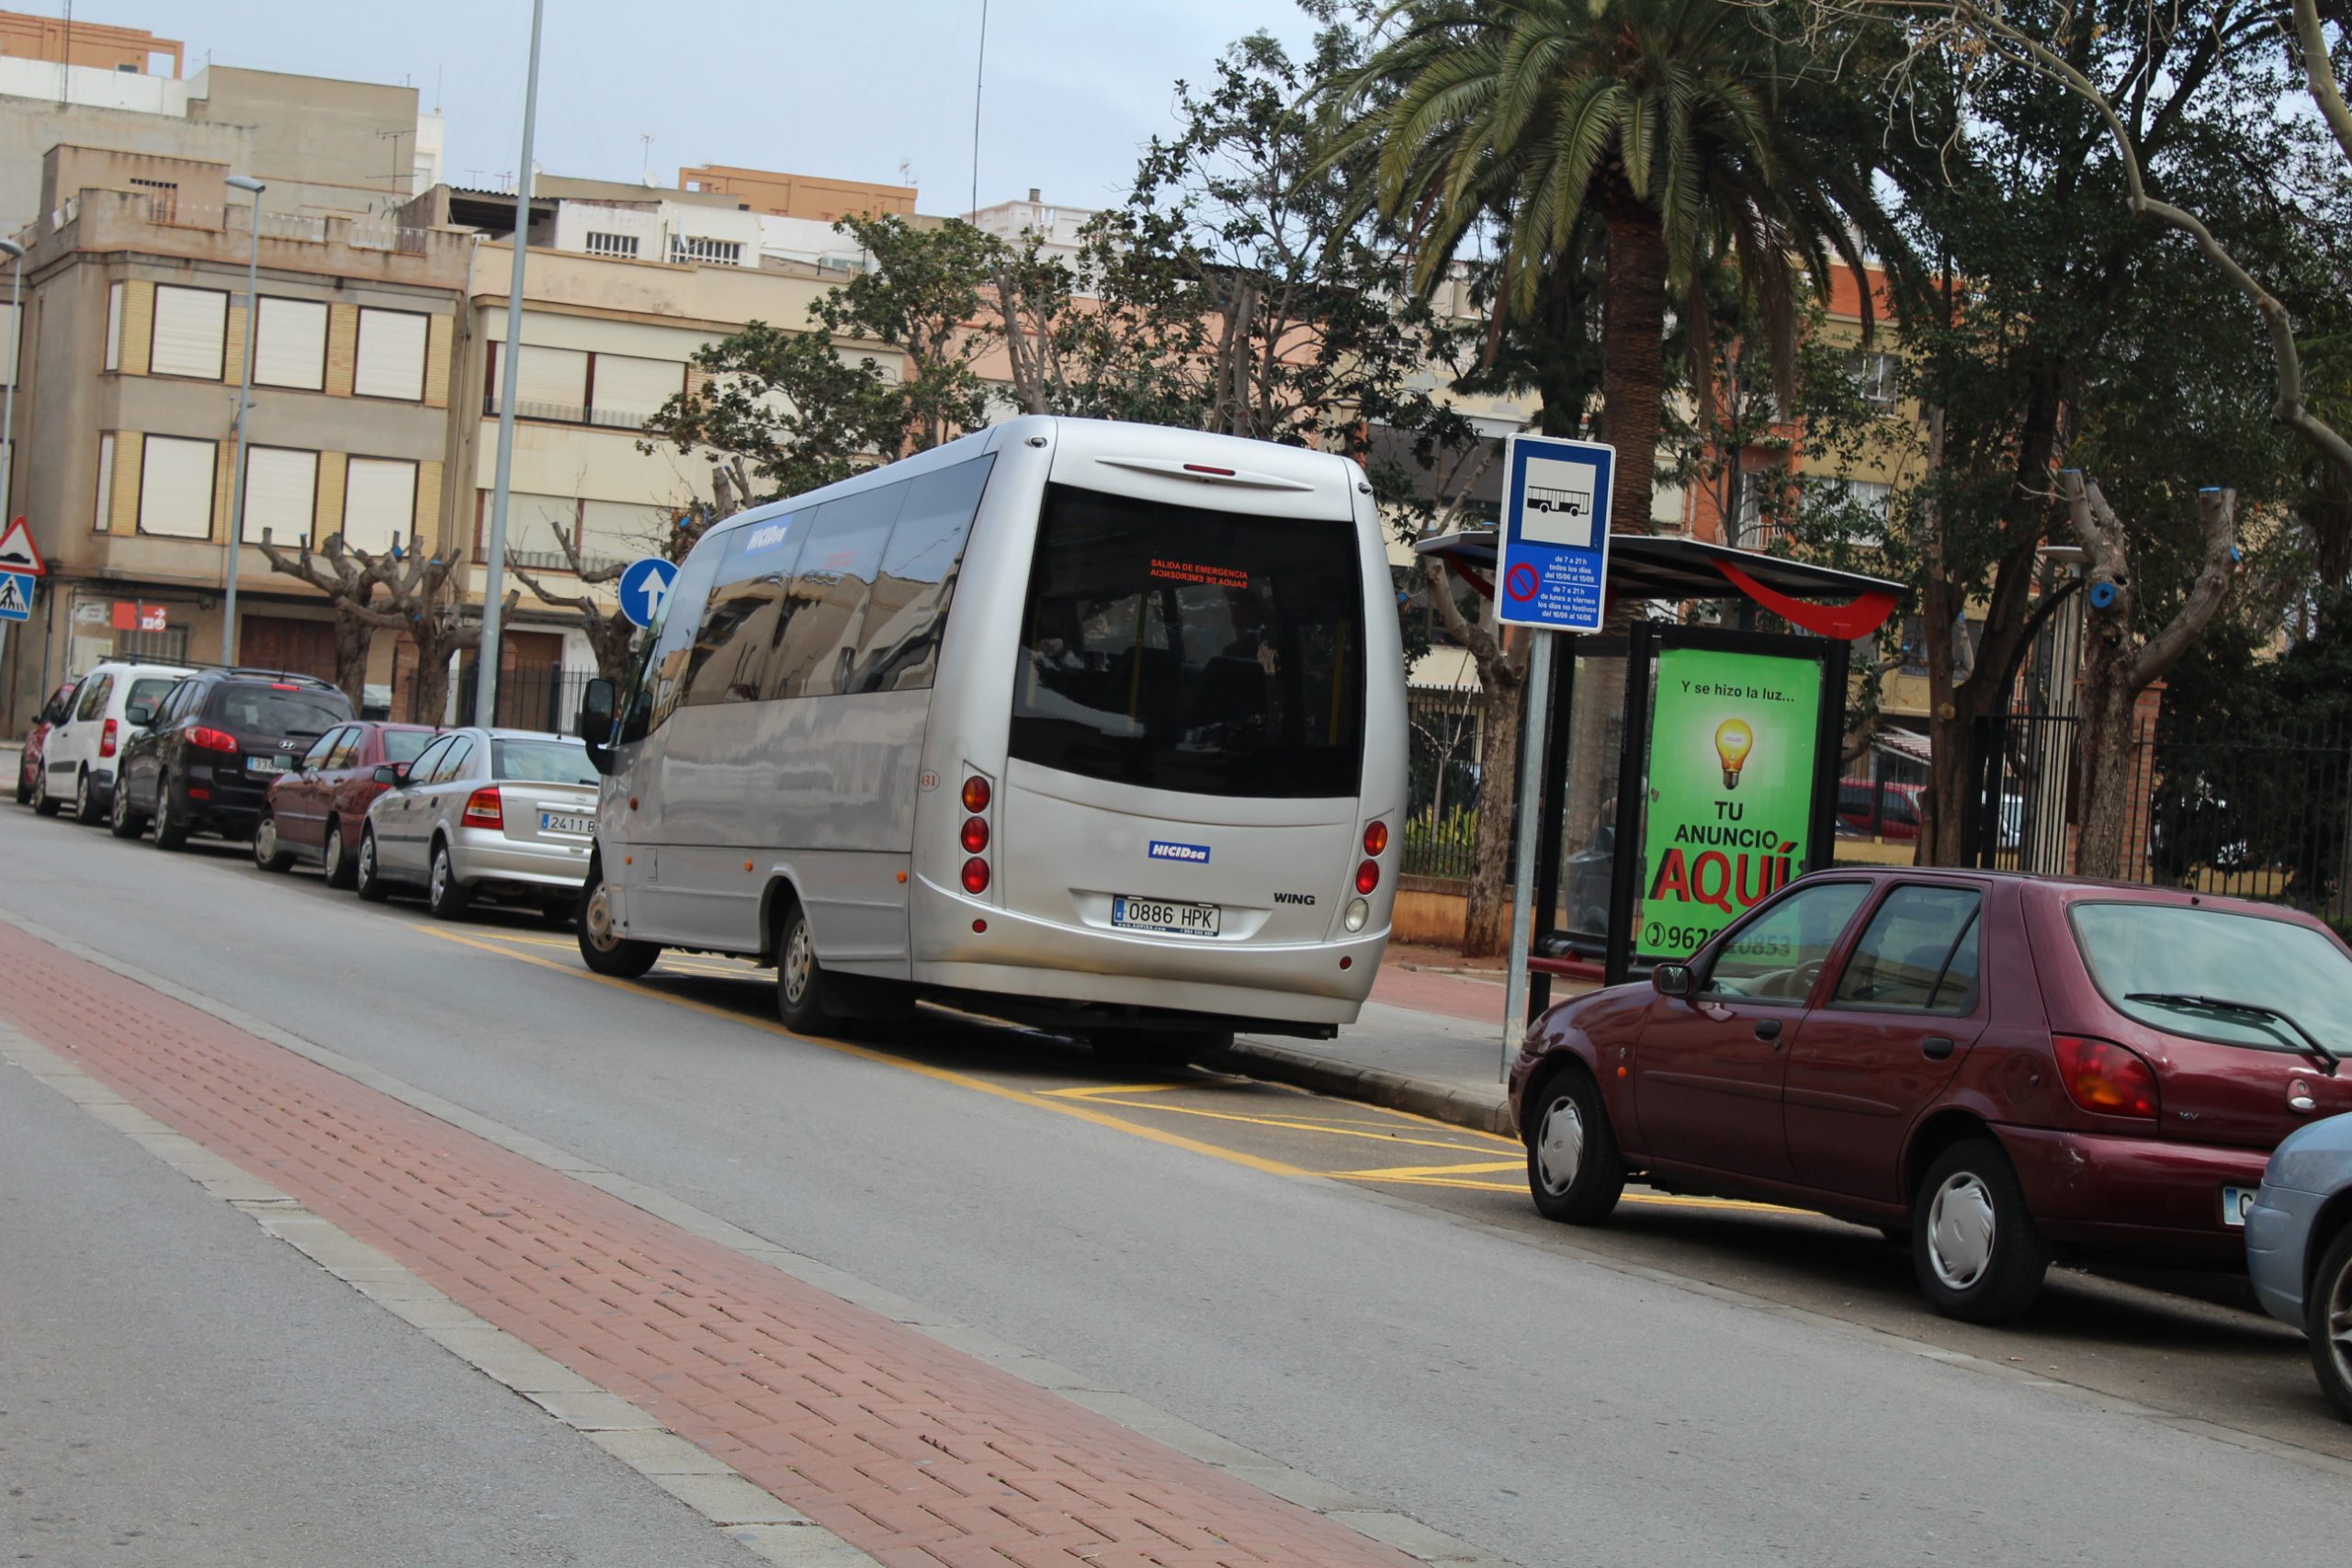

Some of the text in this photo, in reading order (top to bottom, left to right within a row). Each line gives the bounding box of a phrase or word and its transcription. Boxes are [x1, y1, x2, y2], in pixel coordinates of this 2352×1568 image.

[1555, 555, 1563, 563] de
[1575, 557, 1581, 565] 21
[1150, 558, 1249, 579] SALIDA DE EMERGENCIA
[1549, 563, 1567, 571] todos
[1567, 565, 1577, 573] los
[1553, 585, 1561, 593] de
[1549, 593, 1566, 602] lunes
[1572, 596, 1596, 605] viernes
[1572, 604, 1597, 614] festivos
[1681, 681, 1794, 703] Y se hizo la luz...
[1714, 801, 1743, 821] TU
[550, 817, 582, 831] 2411
[1674, 824, 1778, 850] ANUNCIO
[1648, 841, 1798, 914] AQUÍ
[1273, 892, 1316, 906] WING
[1129, 903, 1173, 924] 0886
[1182, 908, 1213, 929] HPK
